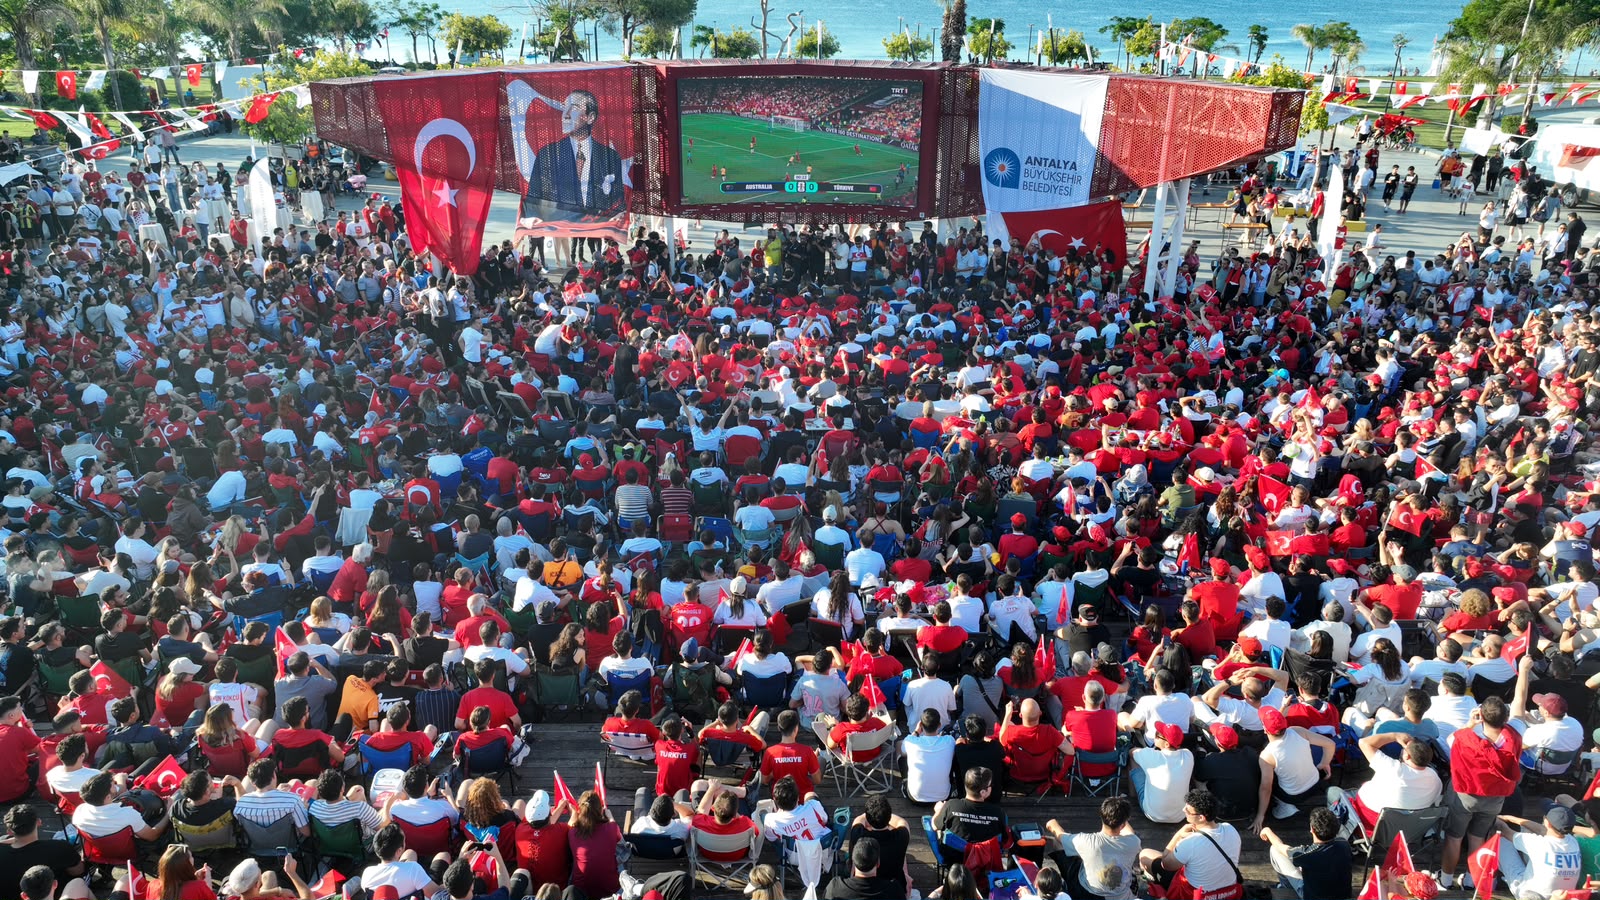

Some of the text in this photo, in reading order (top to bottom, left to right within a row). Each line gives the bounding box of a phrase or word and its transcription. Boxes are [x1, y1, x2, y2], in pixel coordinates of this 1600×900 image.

[846, 130, 883, 143] DESTINATIONS
[900, 141, 919, 152] QATAR
[1024, 155, 1078, 171] ANTALYA
[1023, 167, 1083, 185] BÜYÜKŞEHİR
[788, 183, 794, 191] 0
[809, 183, 815, 191] 0
[1022, 180, 1073, 197] BELEDİYESİ
[782, 817, 808, 834] YILDIZ
